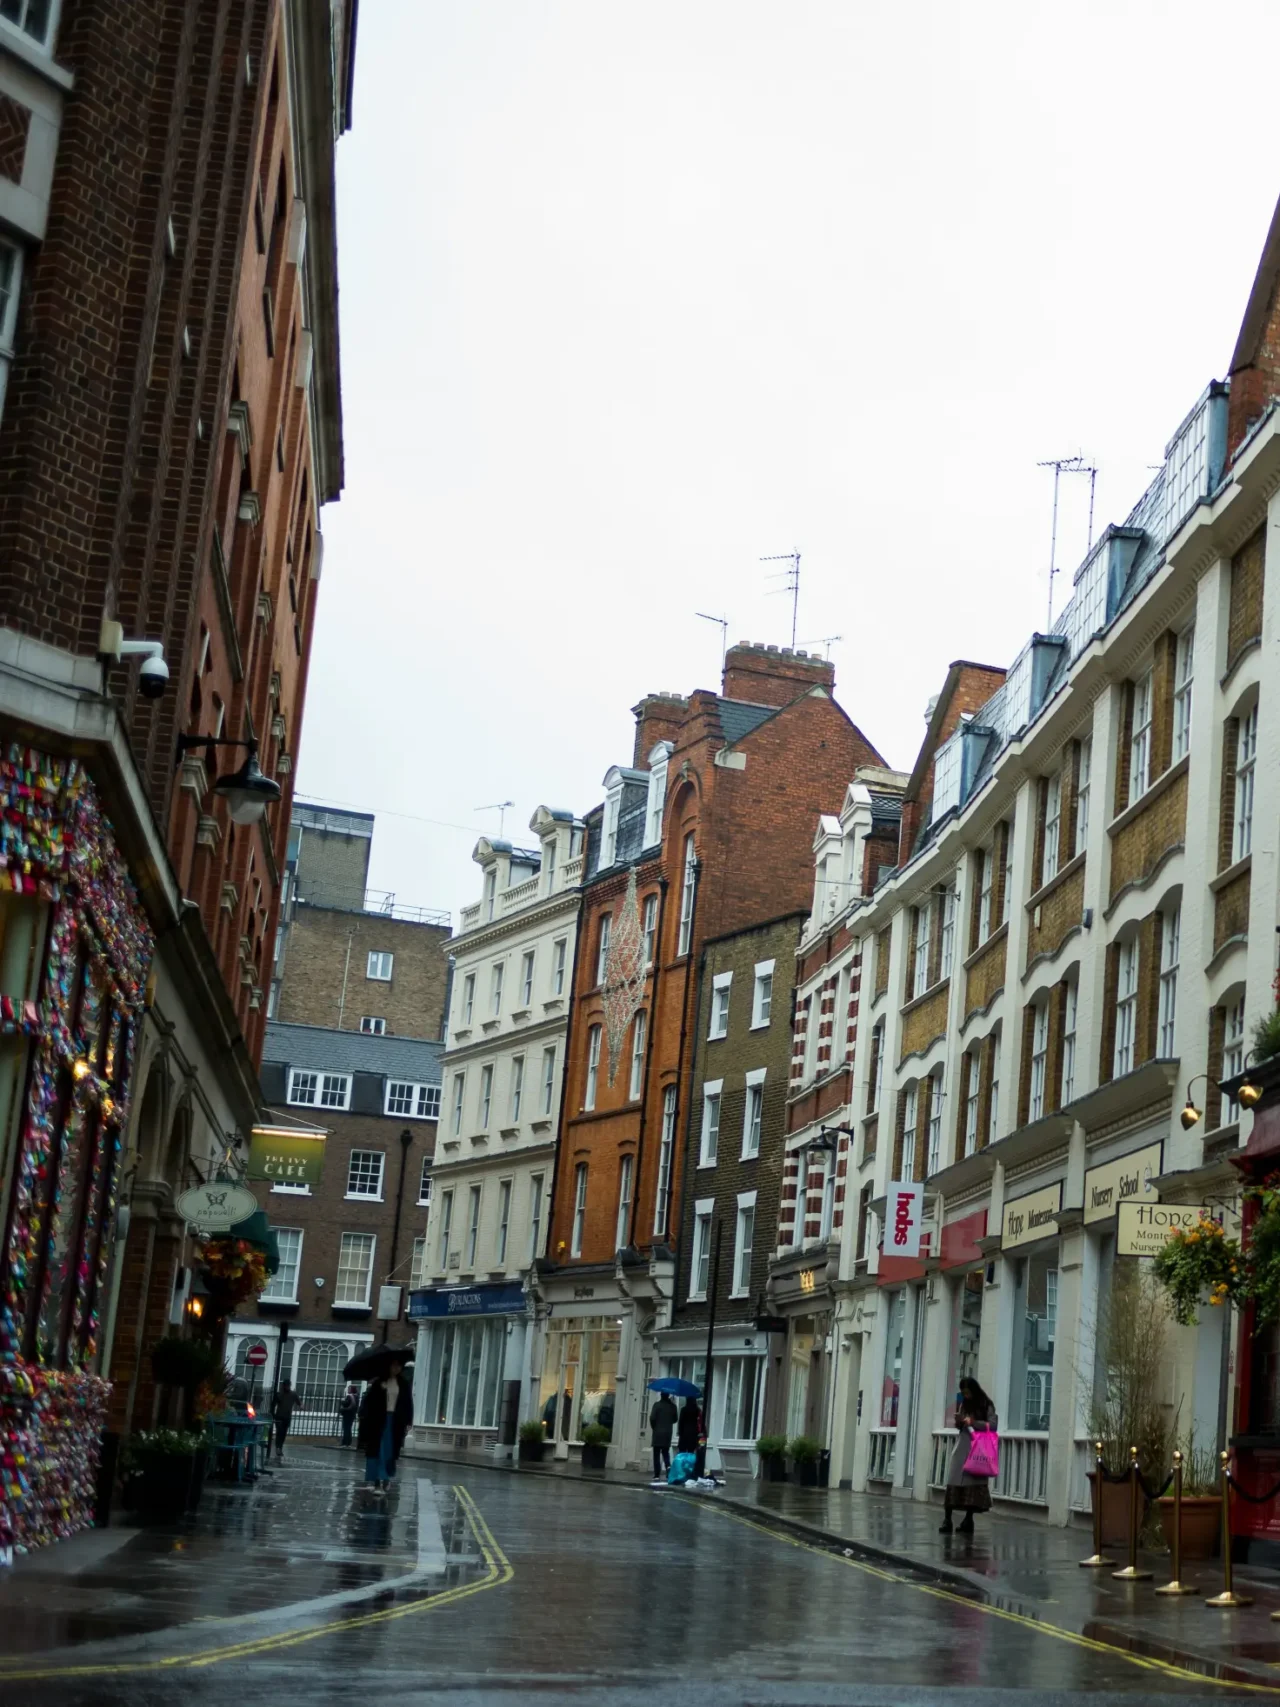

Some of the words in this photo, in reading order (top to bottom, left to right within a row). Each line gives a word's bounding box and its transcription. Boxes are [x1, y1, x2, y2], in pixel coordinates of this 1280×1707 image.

[265, 1155, 285, 1163] THE
[288, 1157, 308, 1165] IVY
[1091, 1185, 1114, 1209] Nursery
[1118, 1170, 1140, 1200] School
[894, 1192, 915, 1246] hobs
[1009, 1211, 1024, 1240] Hope
[1136, 1205, 1194, 1227] Hope
